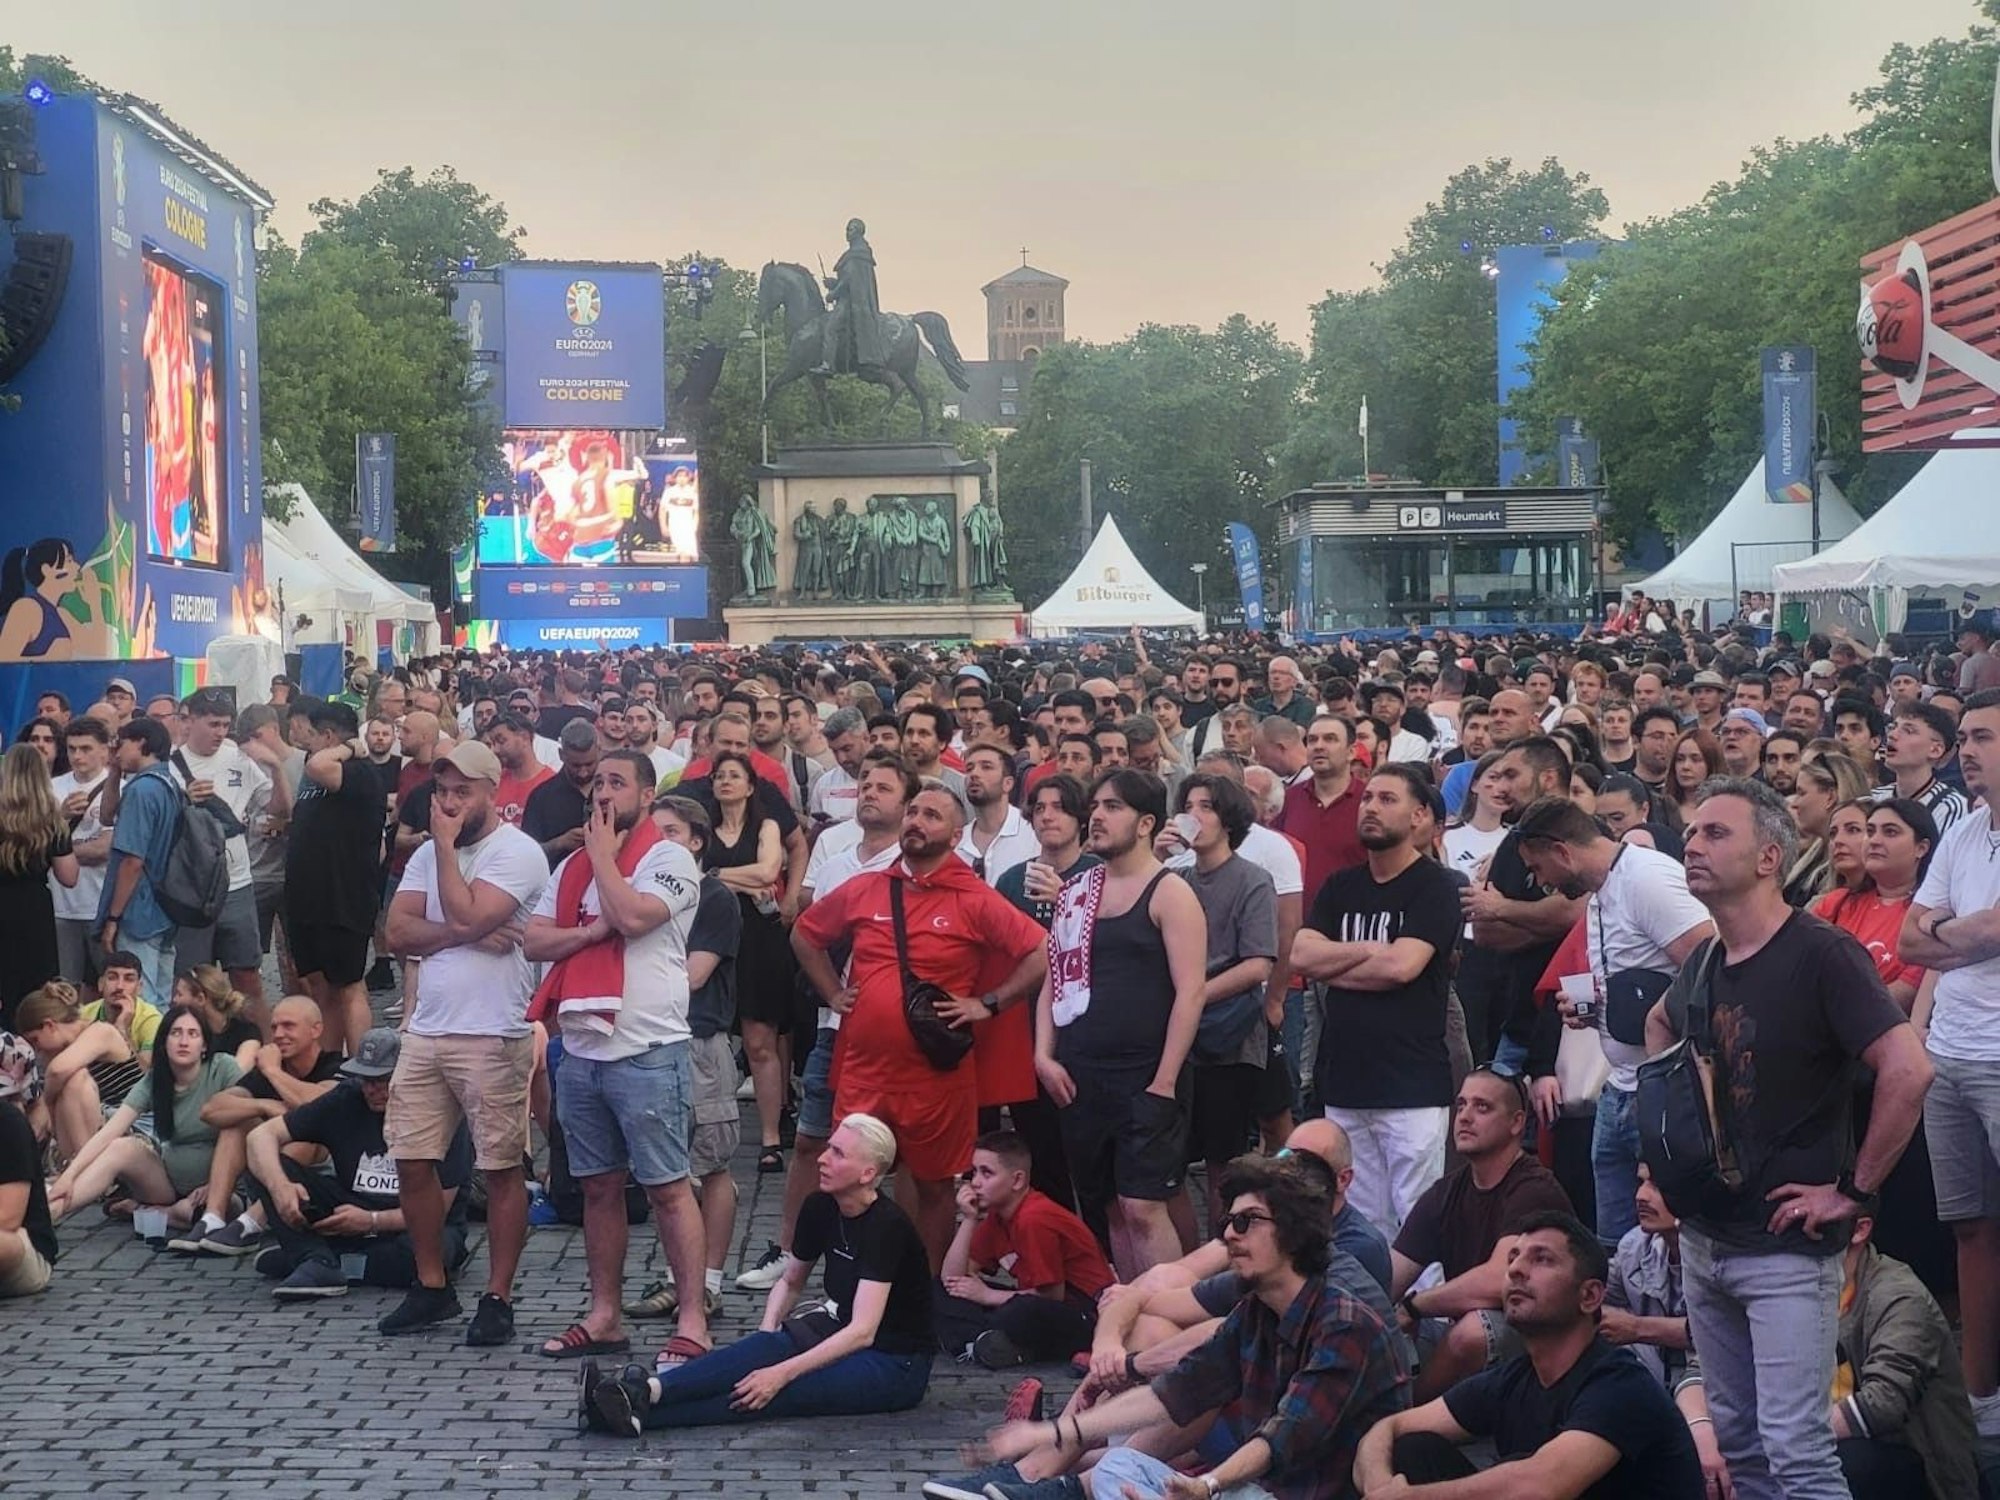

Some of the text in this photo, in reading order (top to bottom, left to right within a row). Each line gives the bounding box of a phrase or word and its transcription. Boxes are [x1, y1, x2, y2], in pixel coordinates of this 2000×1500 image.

[164, 196, 206, 251] COLOGNE
[555, 339, 613, 351] EURO2024
[539, 379, 631, 388] EURO 2024 FESTIVAL
[546, 388, 624, 401] COLOGNE
[1447, 510, 1501, 522] Heumarkt
[1075, 585, 1152, 603] Bitburger
[356, 1174, 401, 1190] LOND
